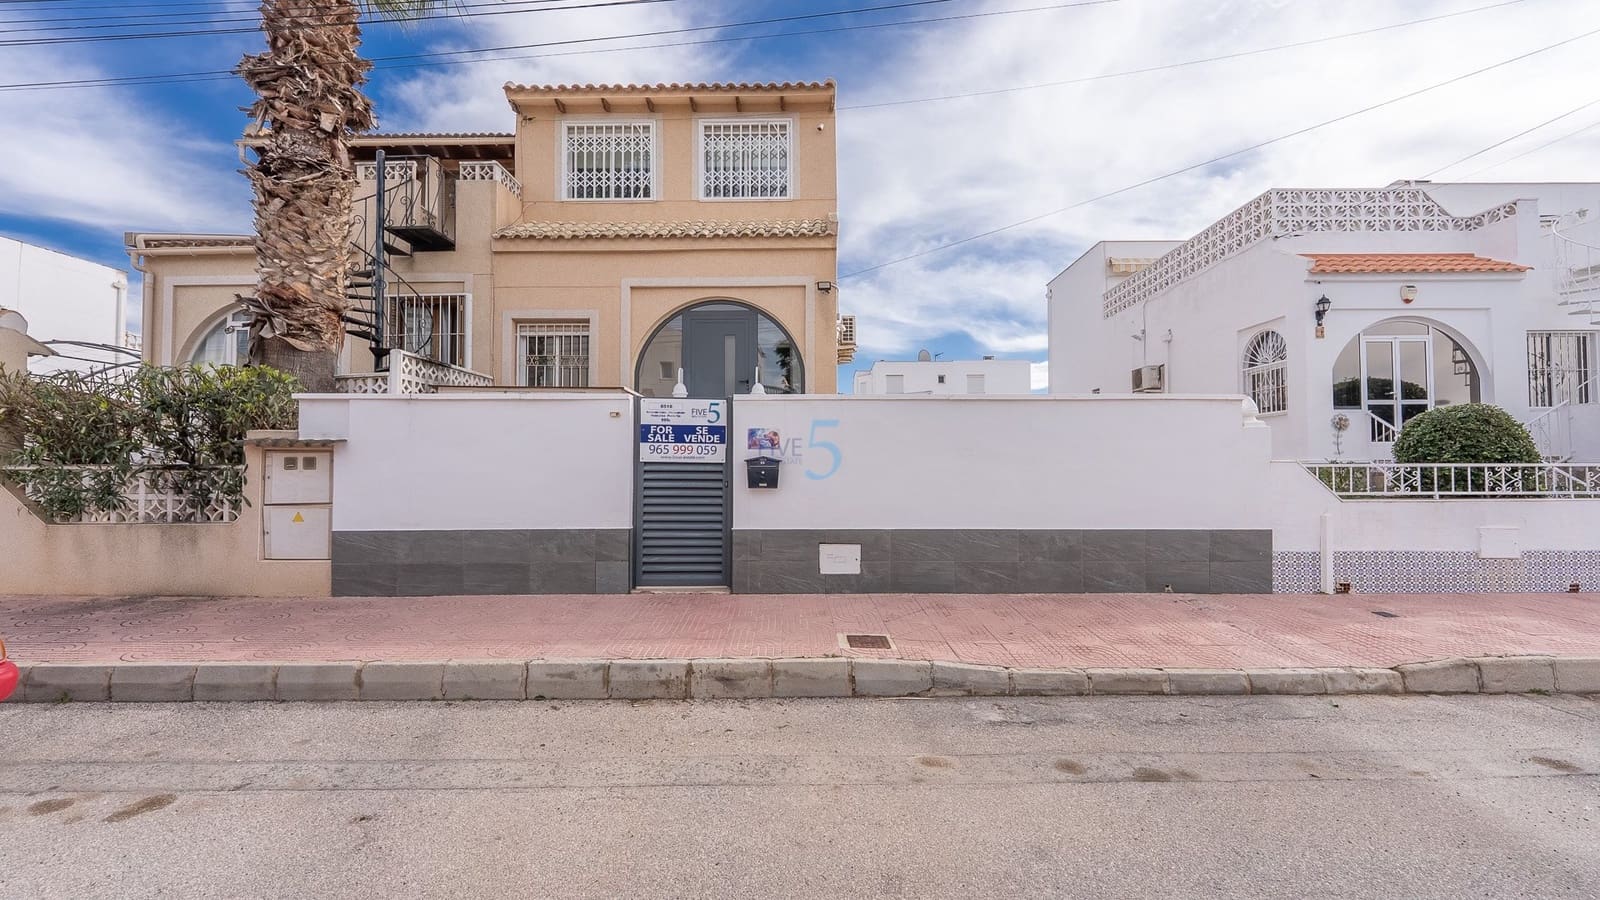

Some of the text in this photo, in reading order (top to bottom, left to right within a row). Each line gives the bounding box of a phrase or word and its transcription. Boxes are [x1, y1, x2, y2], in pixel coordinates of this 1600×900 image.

[691, 402, 720, 424] FIVE 5
[650, 425, 673, 434] FOR
[695, 426, 709, 435] SE
[647, 433, 675, 442] SALE
[683, 434, 720, 443] VENDE
[648, 444, 718, 455] 965 999 059
